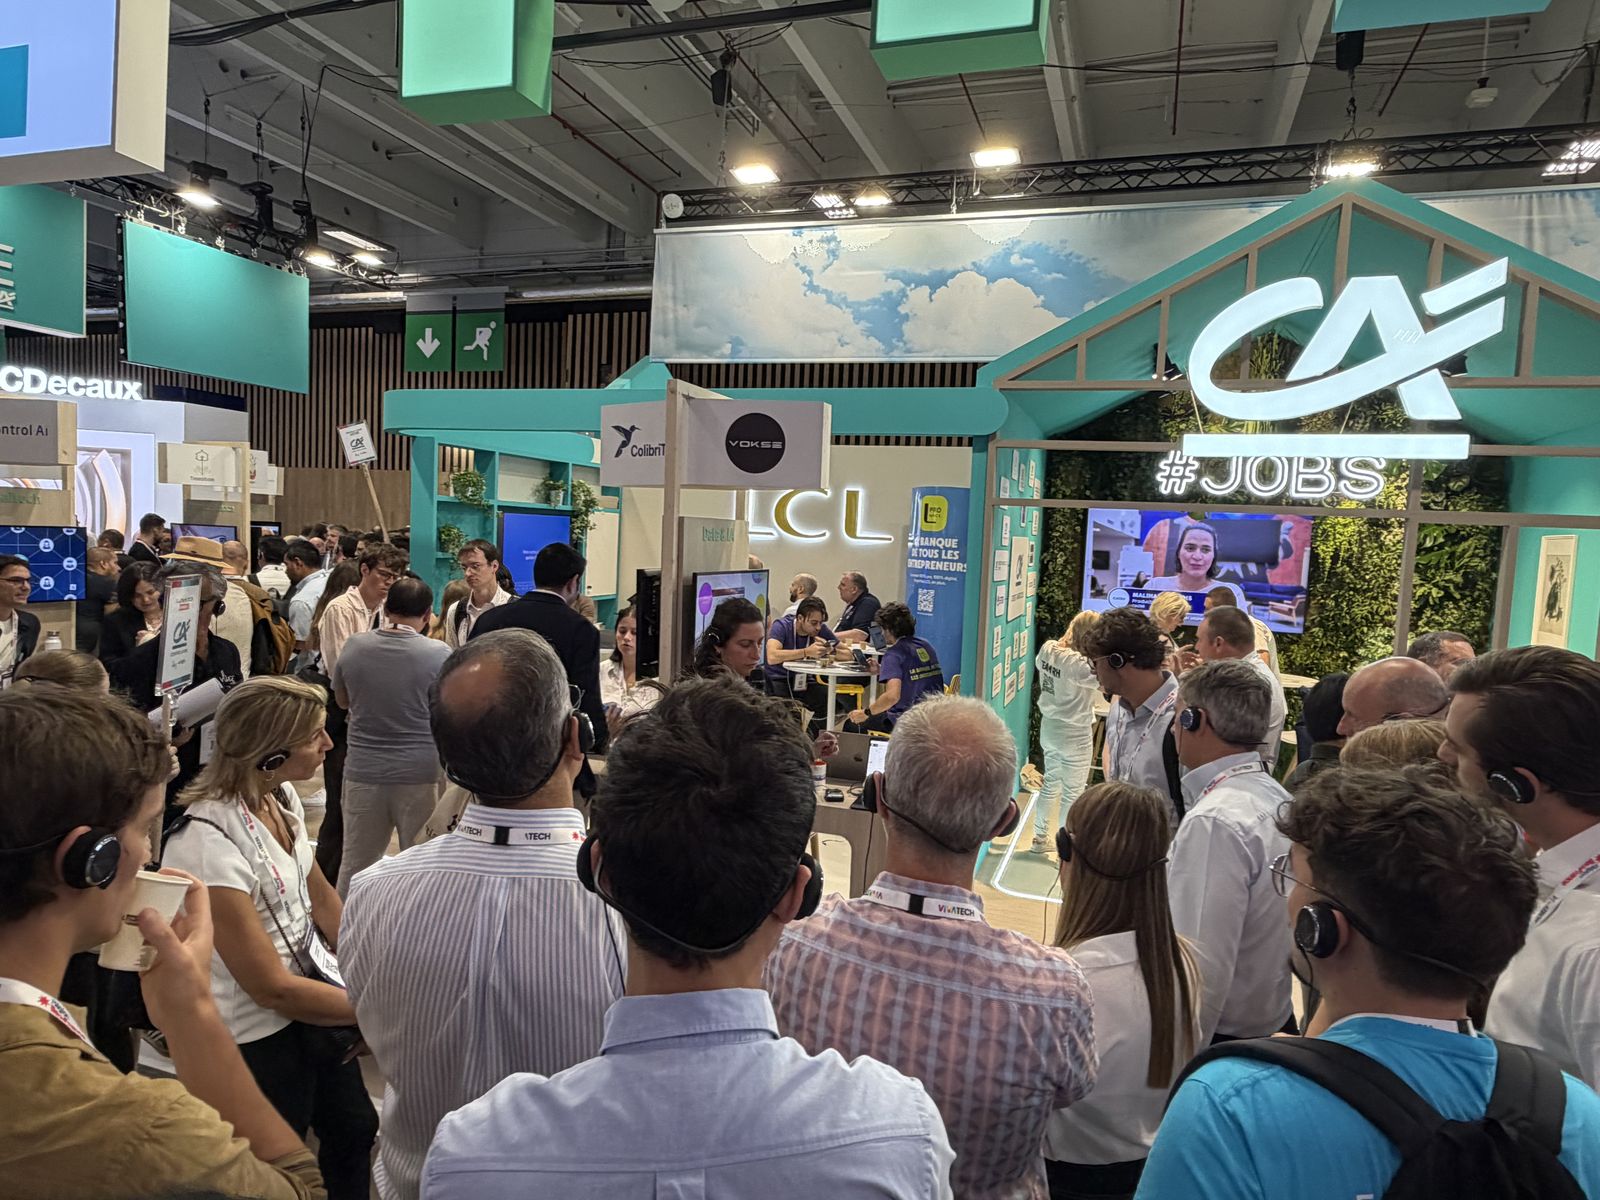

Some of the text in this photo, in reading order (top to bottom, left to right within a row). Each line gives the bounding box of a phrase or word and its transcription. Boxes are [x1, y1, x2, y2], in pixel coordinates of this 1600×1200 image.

[728, 439, 783, 450] VOKSE
[1155, 449, 1386, 500] #JOBS
[734, 488, 895, 544] LCL
[920, 537, 959, 549] BANQUE
[919, 548, 939, 558] TOUS
[941, 550, 960, 560] LES
[938, 904, 975, 917] VIVATECH
